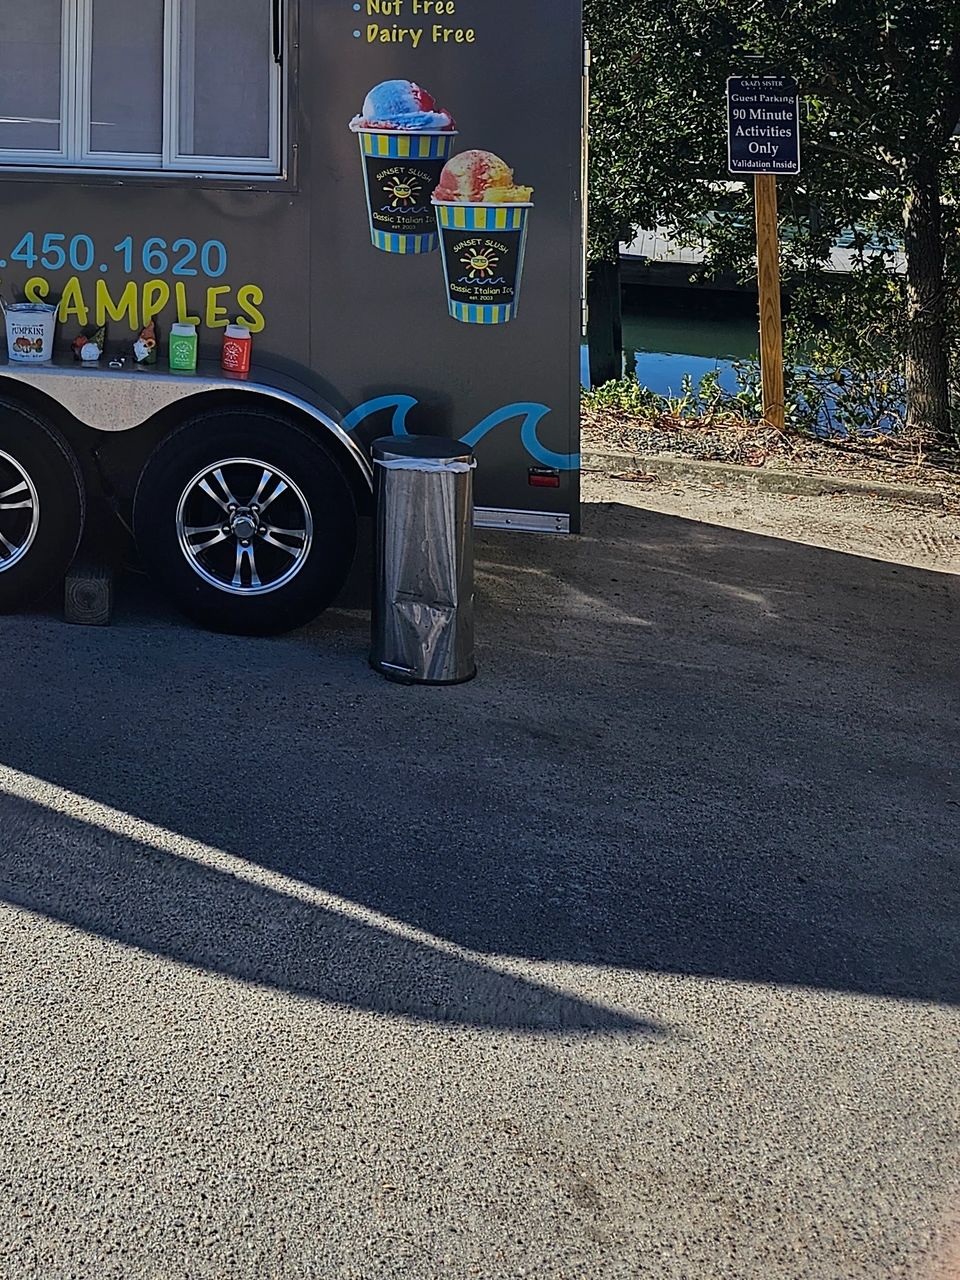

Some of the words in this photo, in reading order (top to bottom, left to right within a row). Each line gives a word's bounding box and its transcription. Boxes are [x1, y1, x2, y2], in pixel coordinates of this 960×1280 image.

[366, 23, 423, 49] Dairy
[431, 24, 476, 43] Free
[731, 93, 757, 102] Guest
[760, 94, 795, 105] Parking
[733, 108, 746, 120] 90
[749, 108, 793, 120] Minute
[735, 125, 792, 138] Activities
[748, 141, 779, 158] Only
[732, 160, 771, 168] Validation
[773, 160, 797, 169] Inside
[376, 166, 406, 181] SUNSET
[407, 167, 433, 183] SLUSH
[396, 215, 424, 224] Italian
[453, 238, 483, 253] SUNSET
[484, 239, 509, 254] SLUSH
[474, 286, 501, 295] Italian
[24, 275, 266, 334] SAMPLES
[11, 326, 44, 336] PUMPKINS
